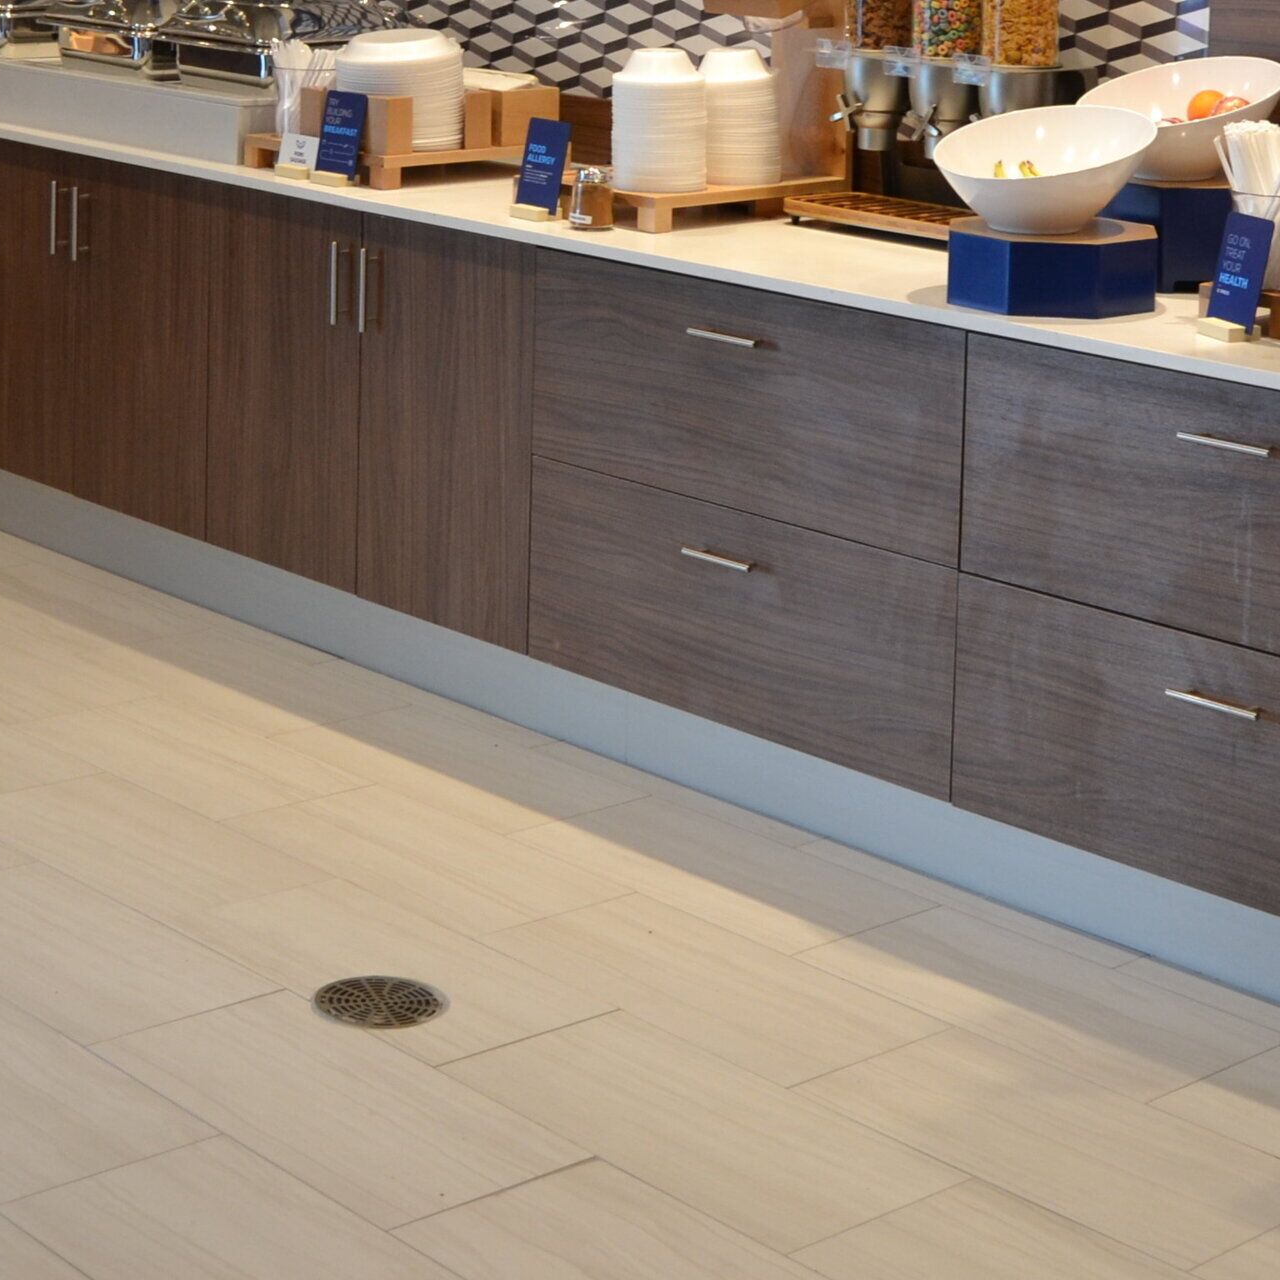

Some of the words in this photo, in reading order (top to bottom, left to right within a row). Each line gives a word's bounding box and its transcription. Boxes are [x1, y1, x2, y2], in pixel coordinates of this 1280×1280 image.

[323, 125, 358, 137] BREAKFAST
[528, 143, 547, 154] FOOD
[527, 153, 556, 165] ALLERGY
[1227, 233, 1238, 245] GO
[1226, 246, 1246, 261] TREAT
[1223, 260, 1242, 272] YOUR
[1219, 272, 1249, 289] HEALTH
